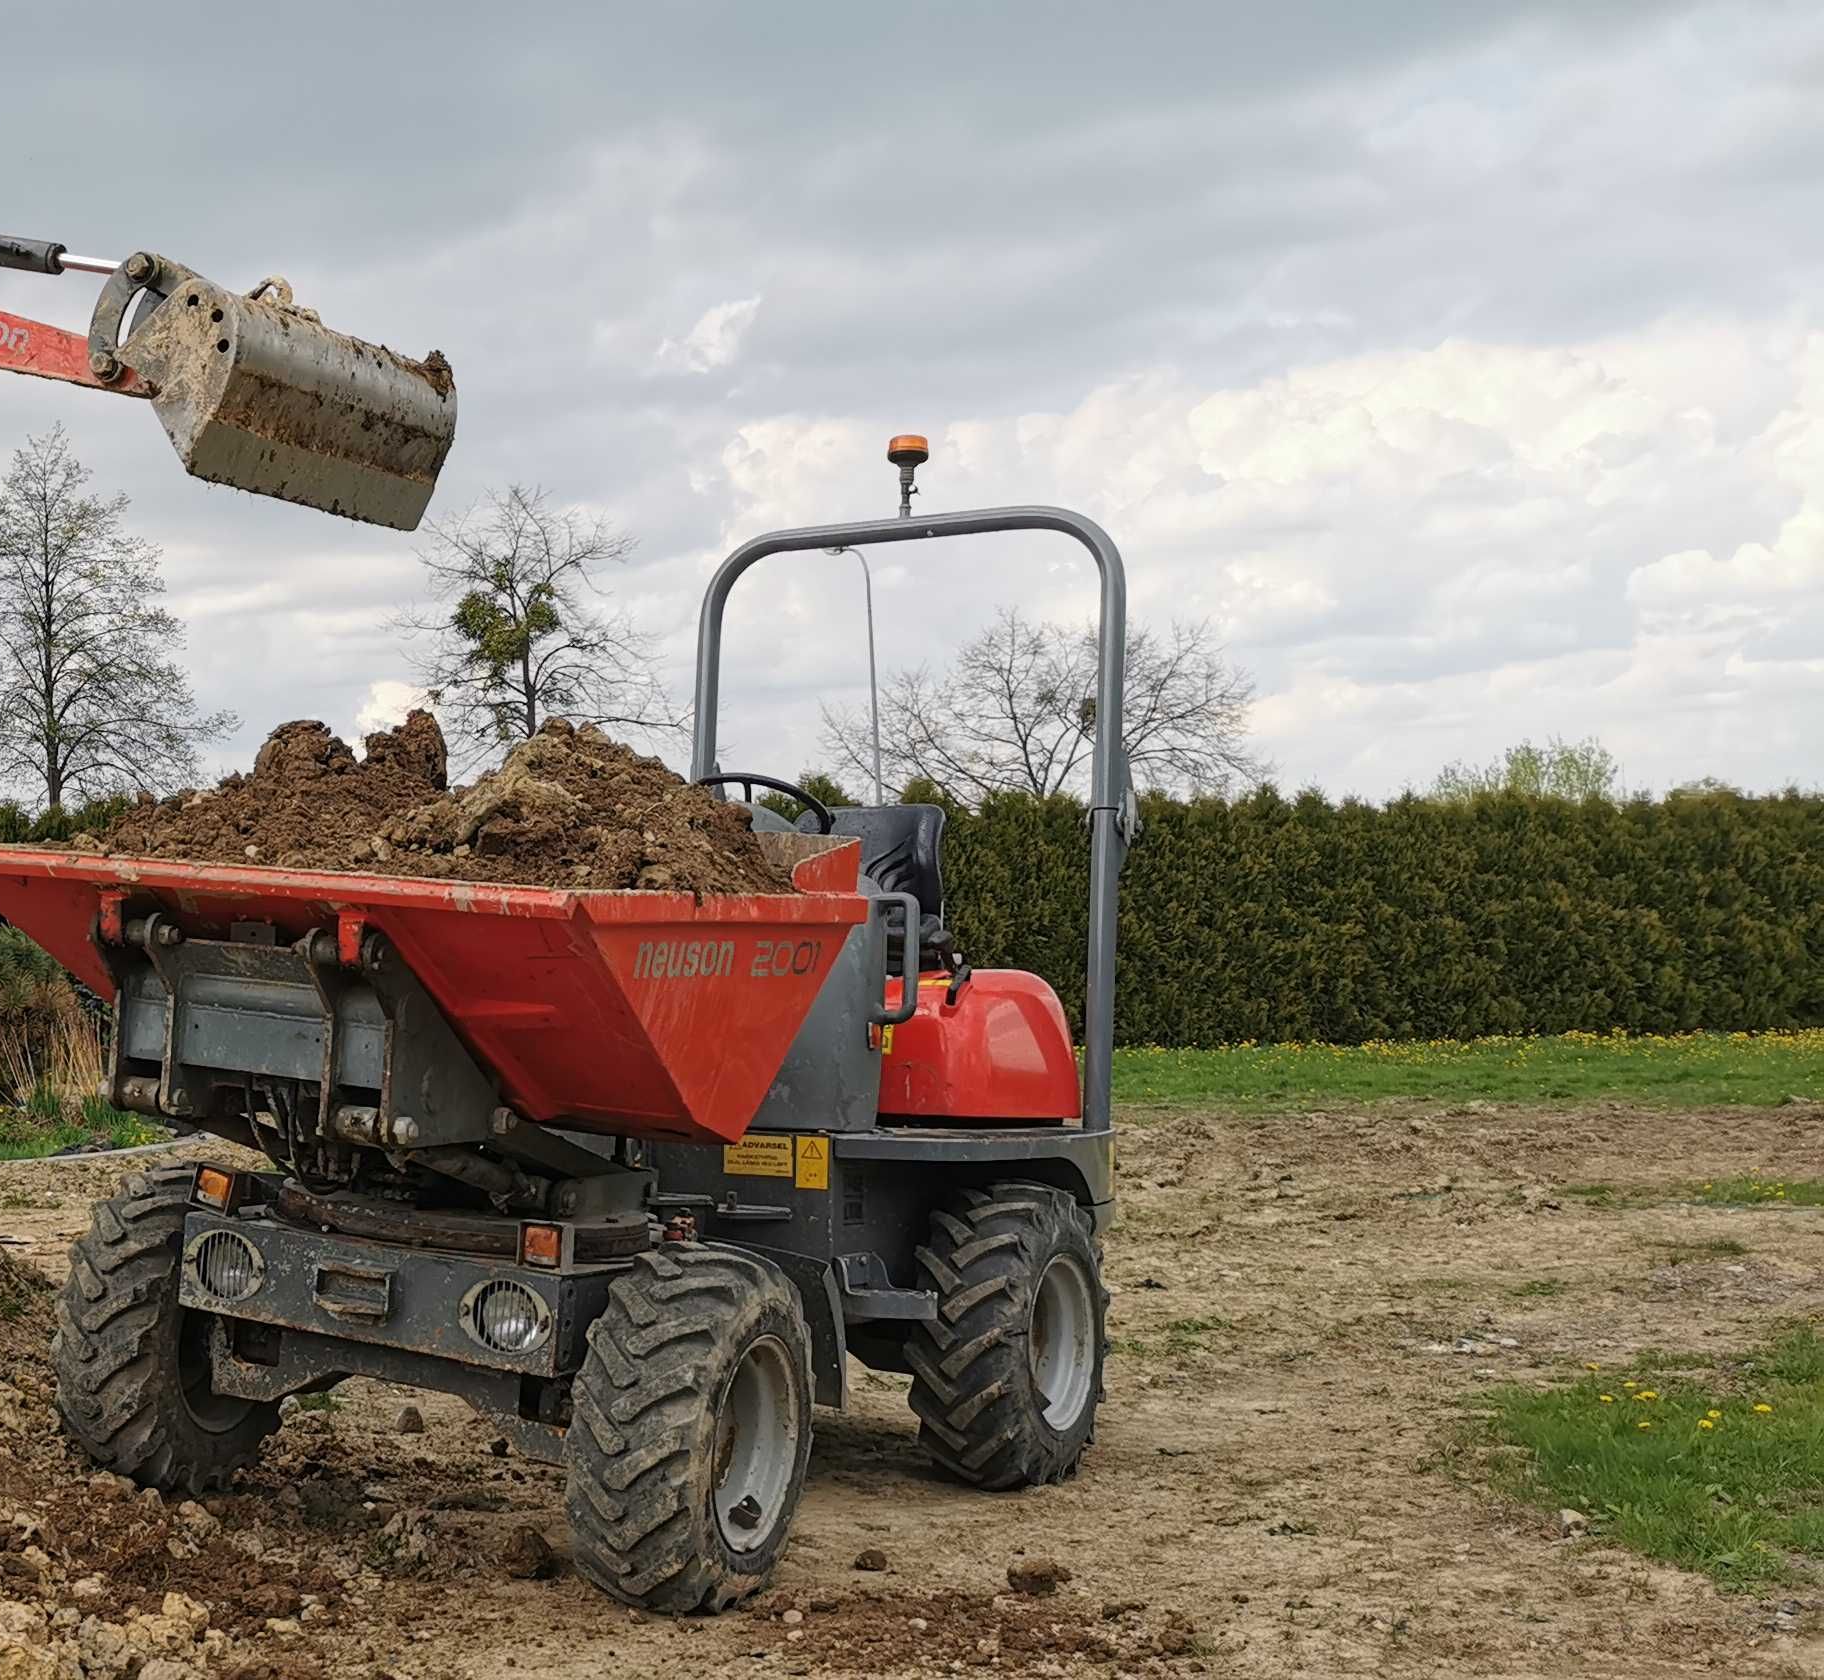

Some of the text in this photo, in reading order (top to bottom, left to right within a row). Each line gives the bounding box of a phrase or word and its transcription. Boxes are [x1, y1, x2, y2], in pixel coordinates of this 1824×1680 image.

[634, 940, 822, 979] neuson 2001
[742, 1141, 788, 1150] ADVARSEL
